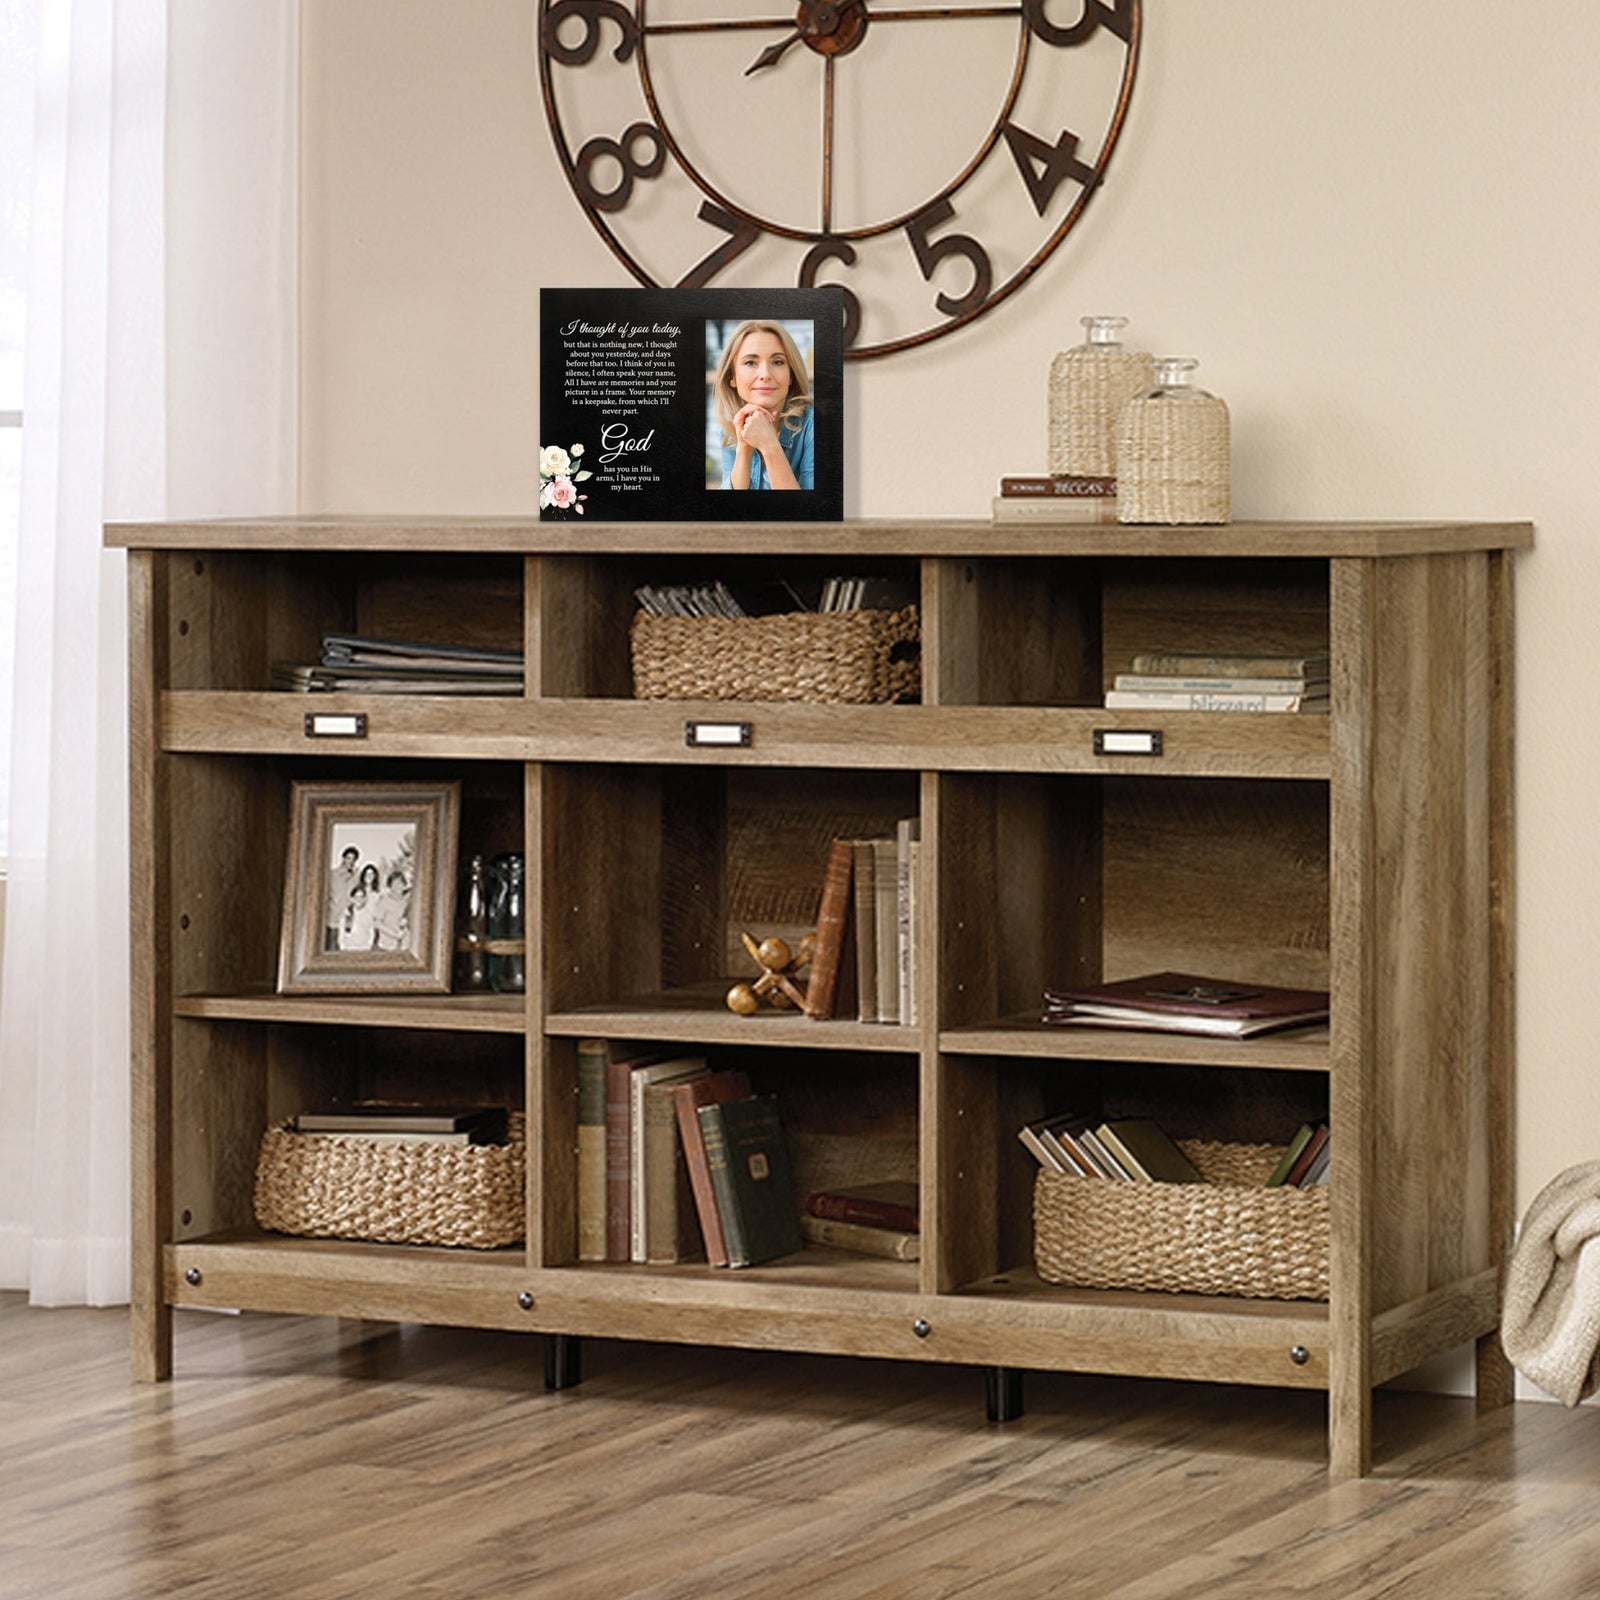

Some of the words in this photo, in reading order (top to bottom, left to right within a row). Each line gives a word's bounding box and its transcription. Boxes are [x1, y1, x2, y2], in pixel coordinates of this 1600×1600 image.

[576, 122, 667, 214] 8
[1001, 120, 1100, 218] 4
[904, 198, 992, 318] 5
[560, 319, 580, 336] I
[580, 322, 616, 338] thought
[618, 322, 629, 338] of
[627, 326, 649, 338] you
[652, 322, 681, 338] today,
[599, 341, 627, 349] nothing
[650, 341, 677, 349] thought
[605, 350, 640, 359] yesterday,
[655, 350, 671, 359] days
[565, 369, 591, 377] silence,
[616, 369, 636, 378] speak
[565, 389, 590, 397] picture
[585, 398, 617, 407] keepsake,
[623, 408, 639, 416] part.
[598, 423, 655, 464] God
